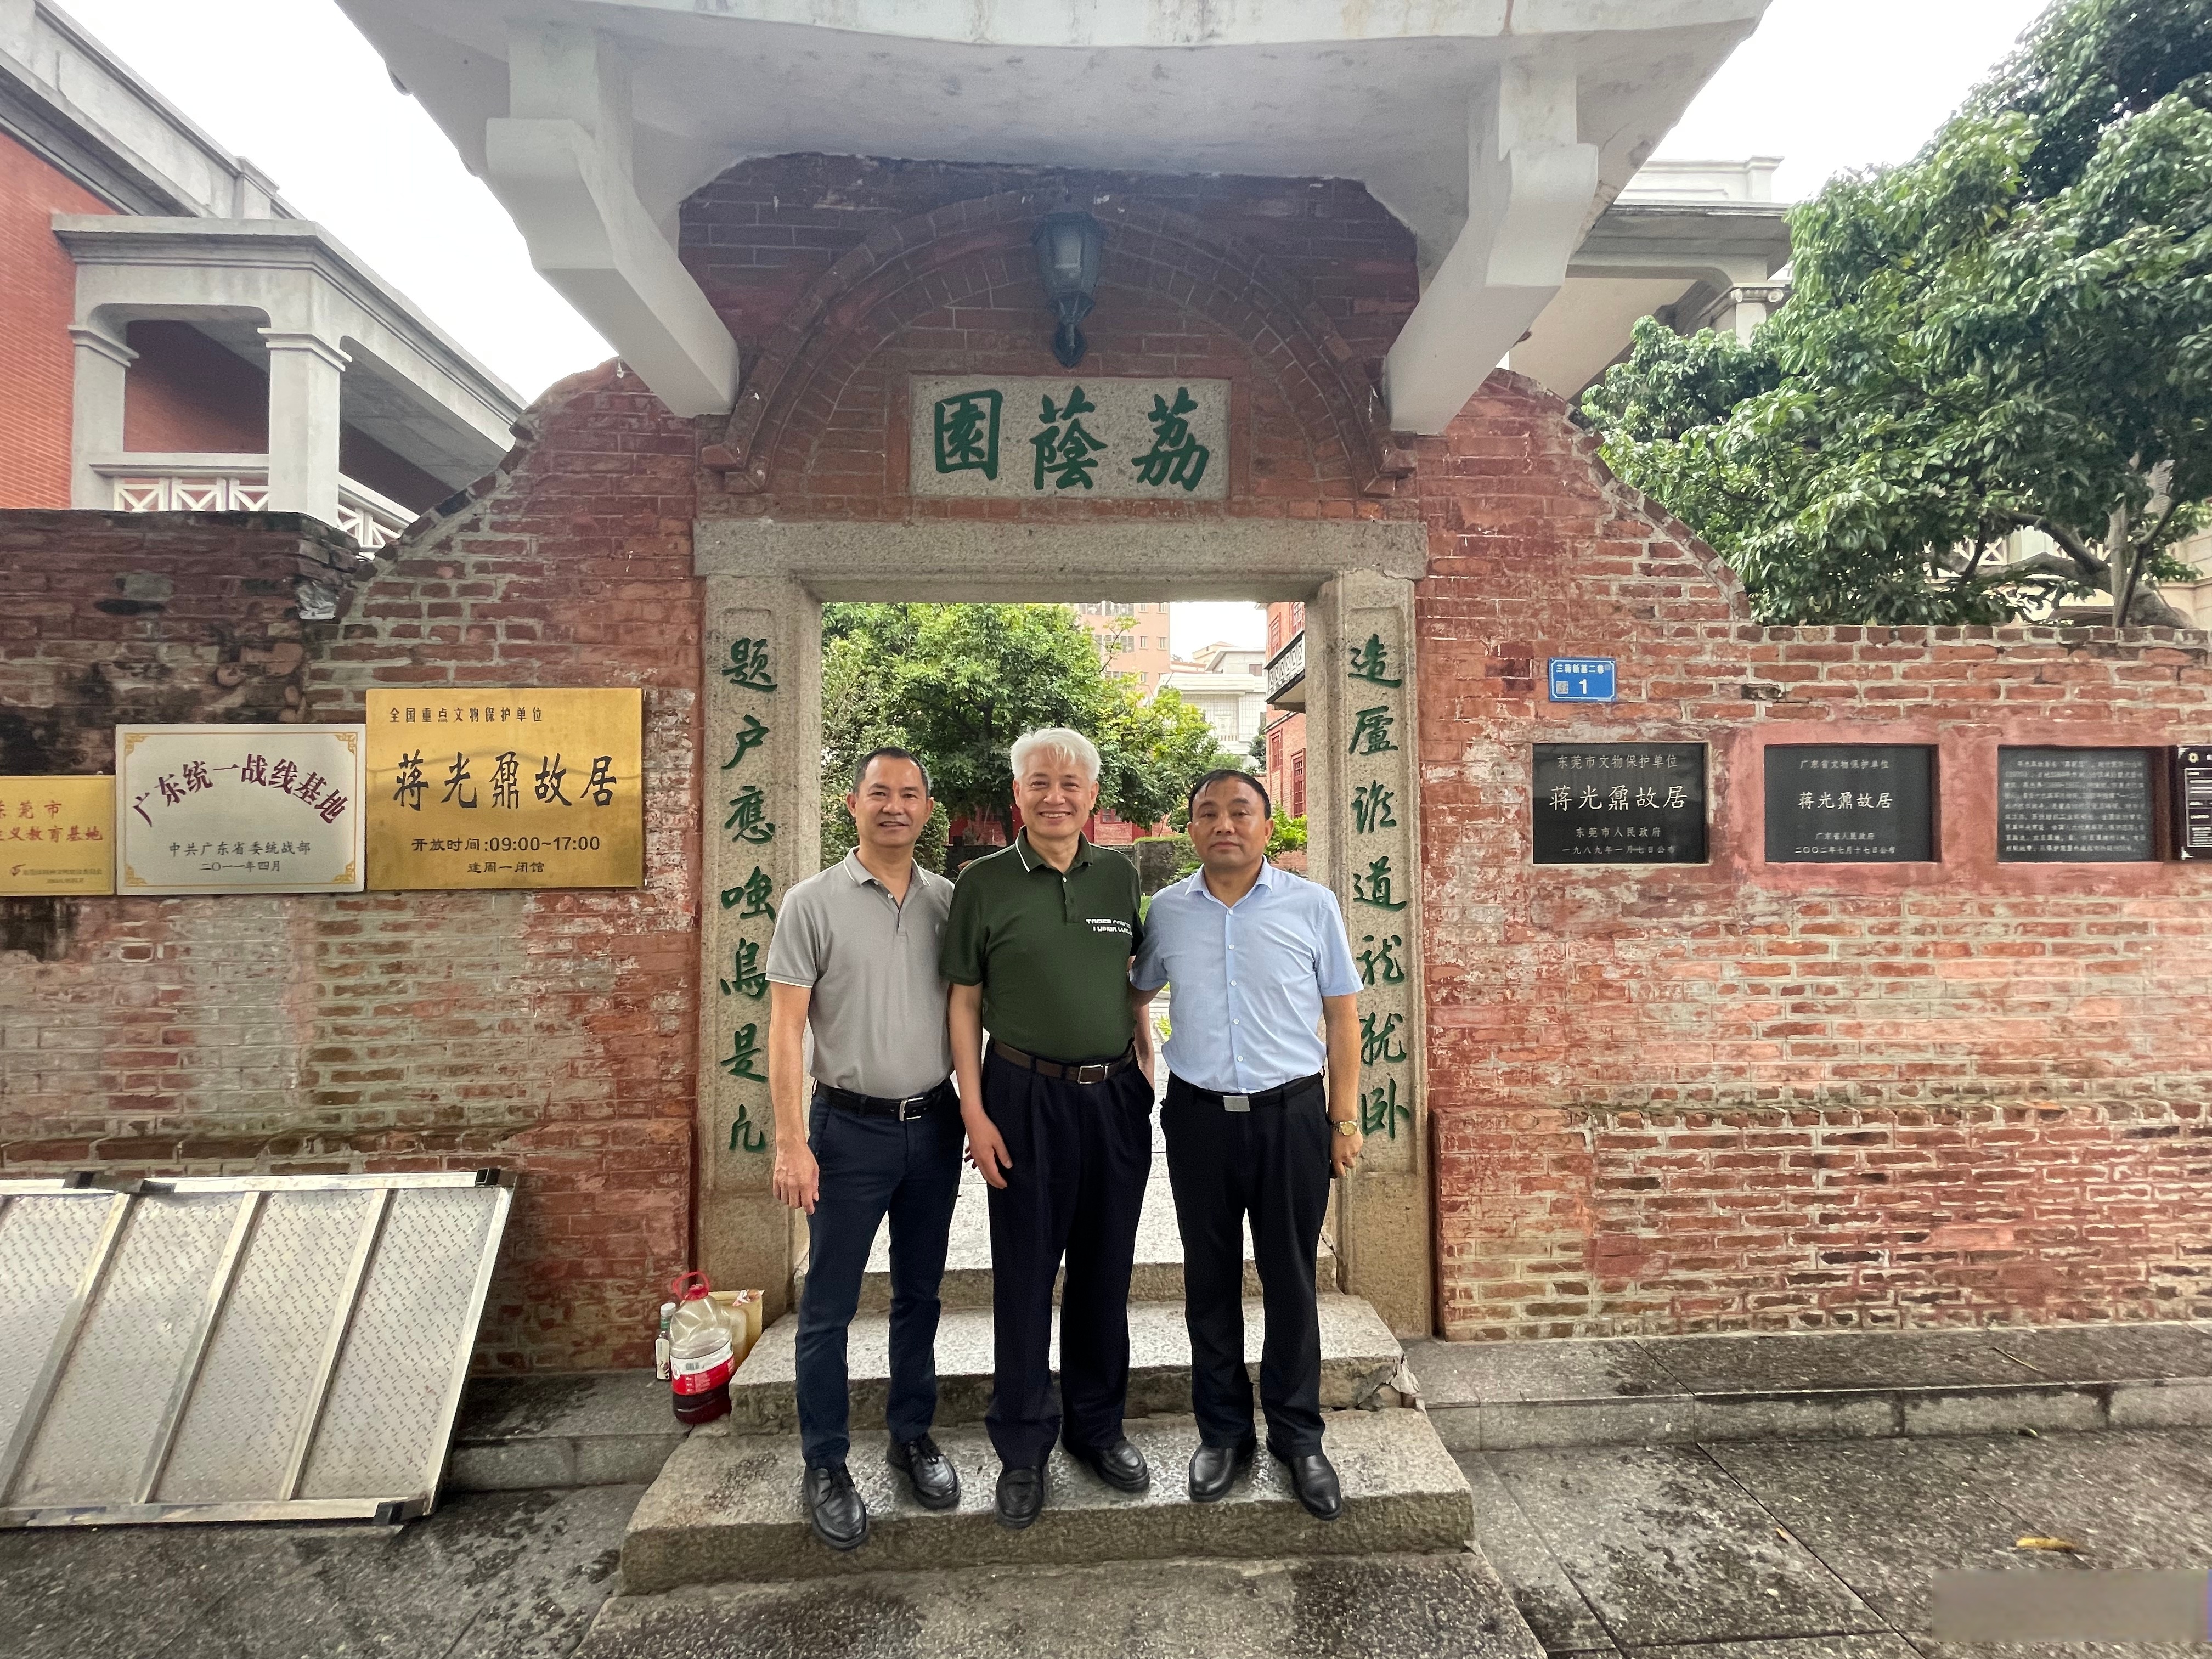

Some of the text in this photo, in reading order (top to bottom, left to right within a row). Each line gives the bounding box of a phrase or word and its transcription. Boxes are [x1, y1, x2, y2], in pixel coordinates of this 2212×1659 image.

[1579, 679, 1587, 695] 1
[390, 707, 543, 723] 全国重点文物保护单位
[1557, 754, 1678, 769] 东莞市文物保护单位
[393, 749, 617, 811] 蒋光鼐故居
[133, 753, 349, 827] 广东统一战线基地
[1549, 785, 1688, 811] 蒋光鼐故居
[1798, 792, 1893, 810] 蒋光鼐故居
[0, 825, 103, 843] 义教育基地
[1576, 827, 1661, 838] 东莞市人民政府
[170, 840, 311, 856] 中共广东省委统战部
[467, 861, 544, 873] 逢周一闭馆
